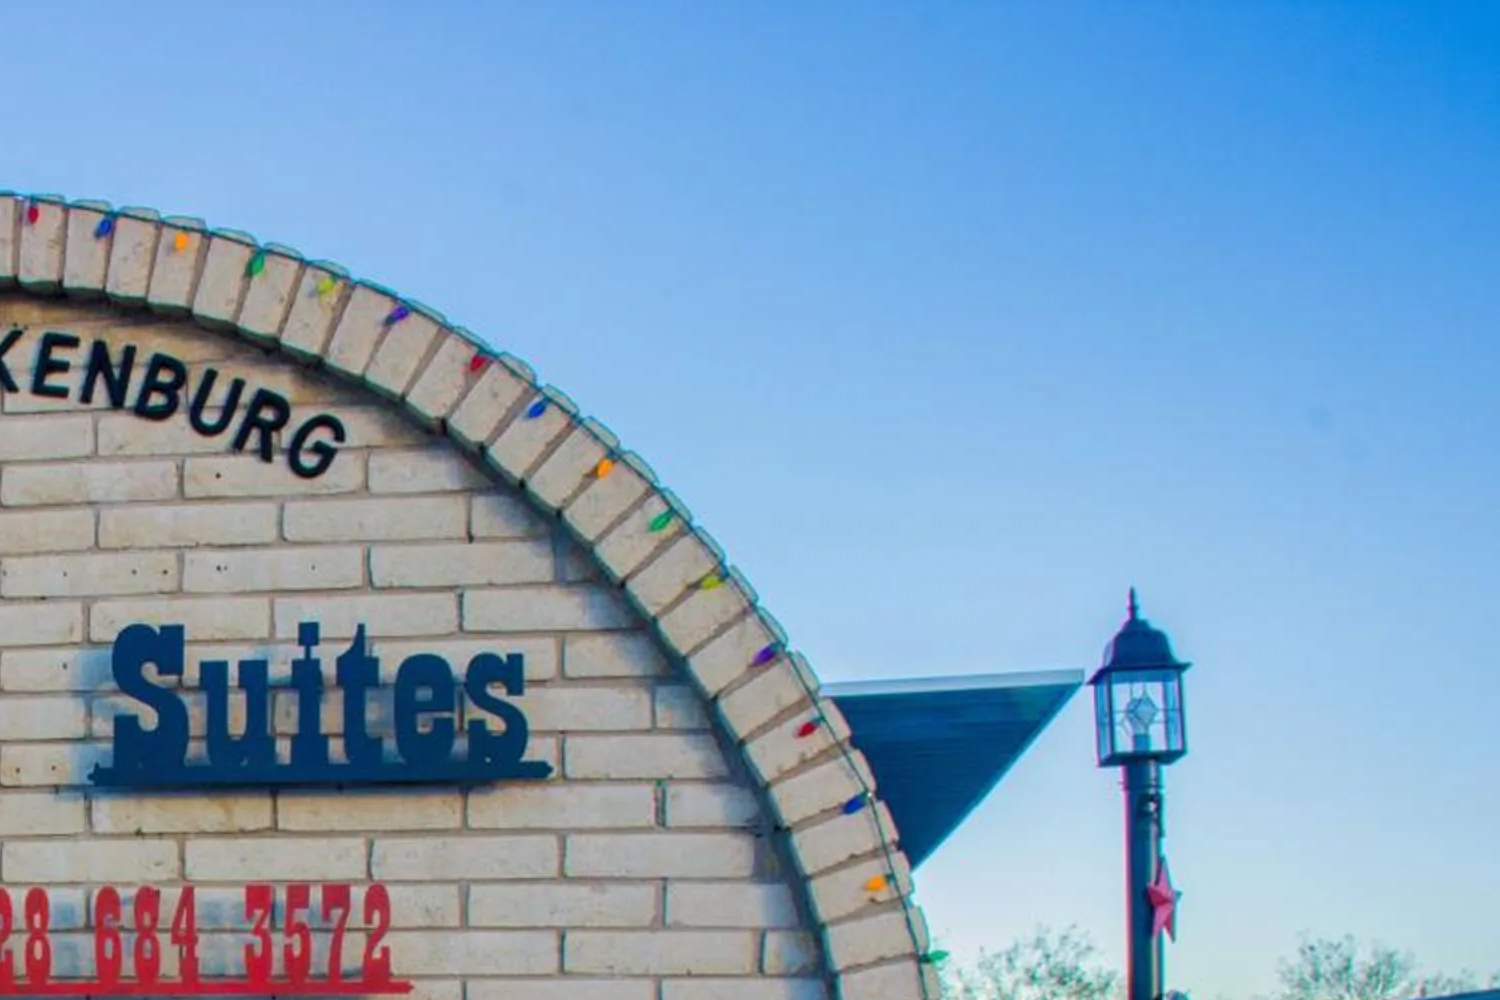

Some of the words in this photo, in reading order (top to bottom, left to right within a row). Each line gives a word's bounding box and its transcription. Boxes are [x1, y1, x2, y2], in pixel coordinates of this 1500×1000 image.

[111, 621, 530, 781] Suites
[95, 882, 201, 984] 684
[244, 881, 392, 983] 3572
